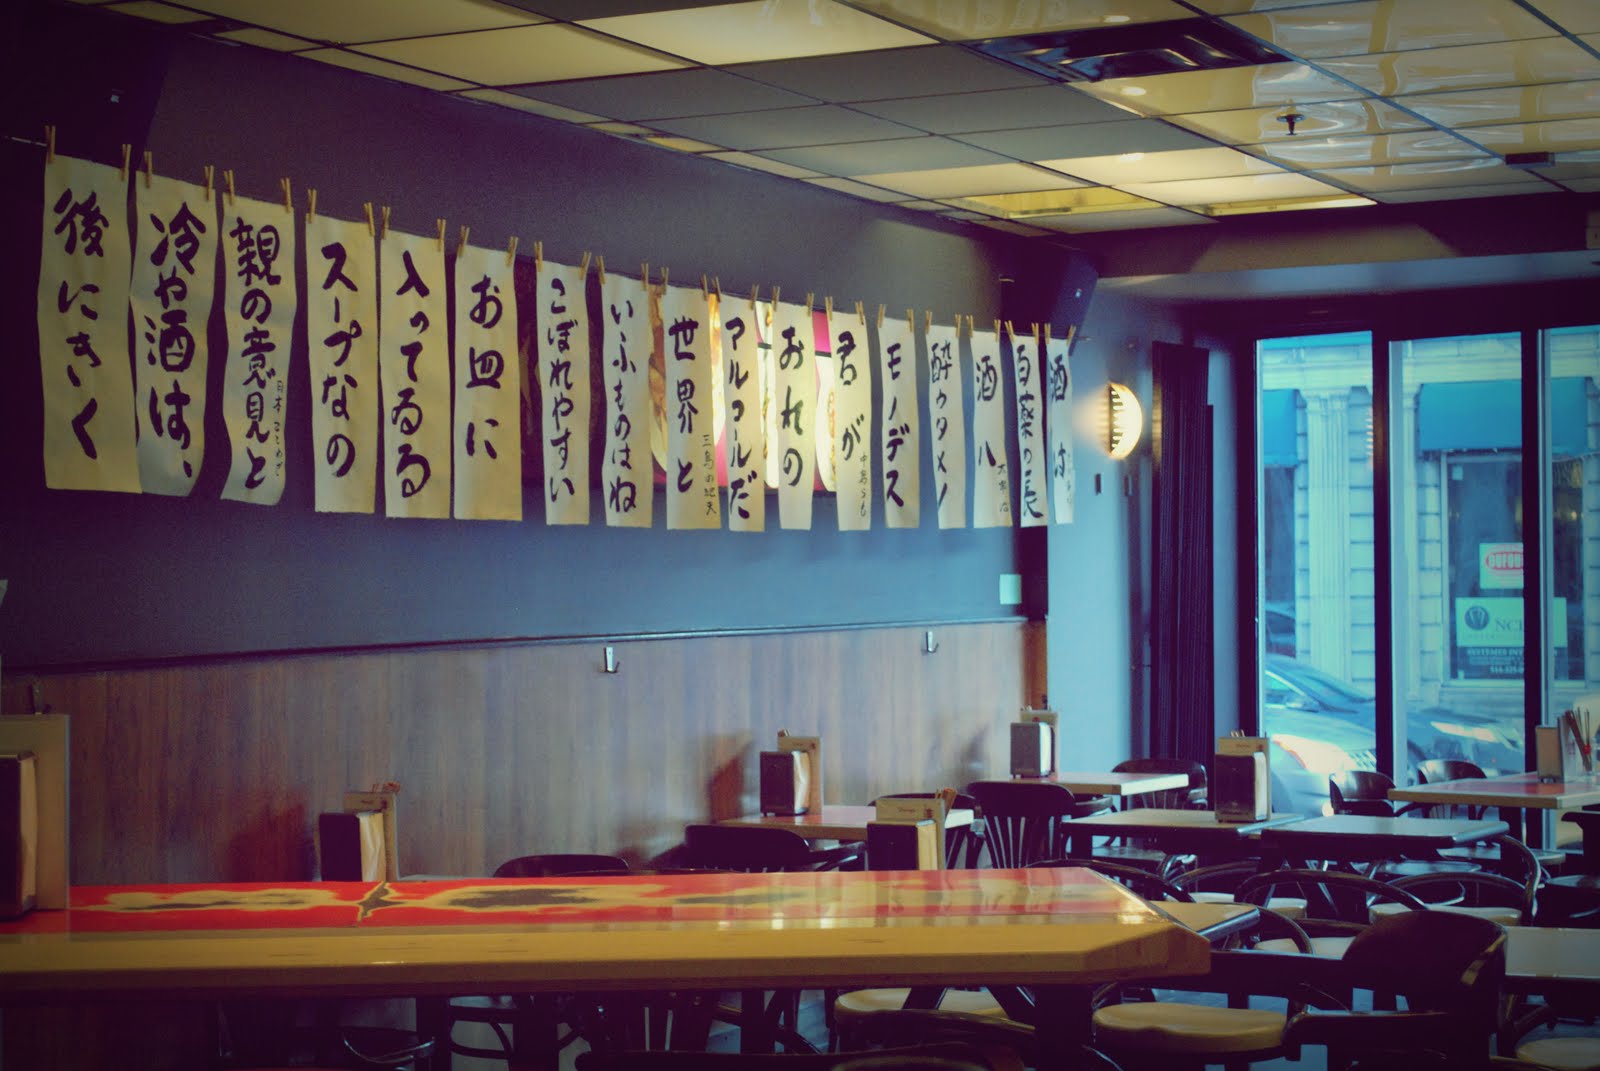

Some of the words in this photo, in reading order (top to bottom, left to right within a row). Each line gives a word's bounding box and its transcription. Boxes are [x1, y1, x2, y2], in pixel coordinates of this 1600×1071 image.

[53, 188, 110, 460] 後にきく
[229, 217, 281, 489] 親の意見と
[321, 242, 362, 477] スープなの
[465, 274, 504, 459] お皿に
[547, 277, 578, 503] こぼれやすい
[609, 300, 637, 513] いふものはね
[668, 316, 699, 493] 世界と
[725, 316, 758, 520] アルコールだ
[779, 326, 804, 487] おれの
[836, 330, 864, 461] 君が
[886, 343, 911, 507] モノデス
[1016, 344, 1043, 518] 百薬の長
